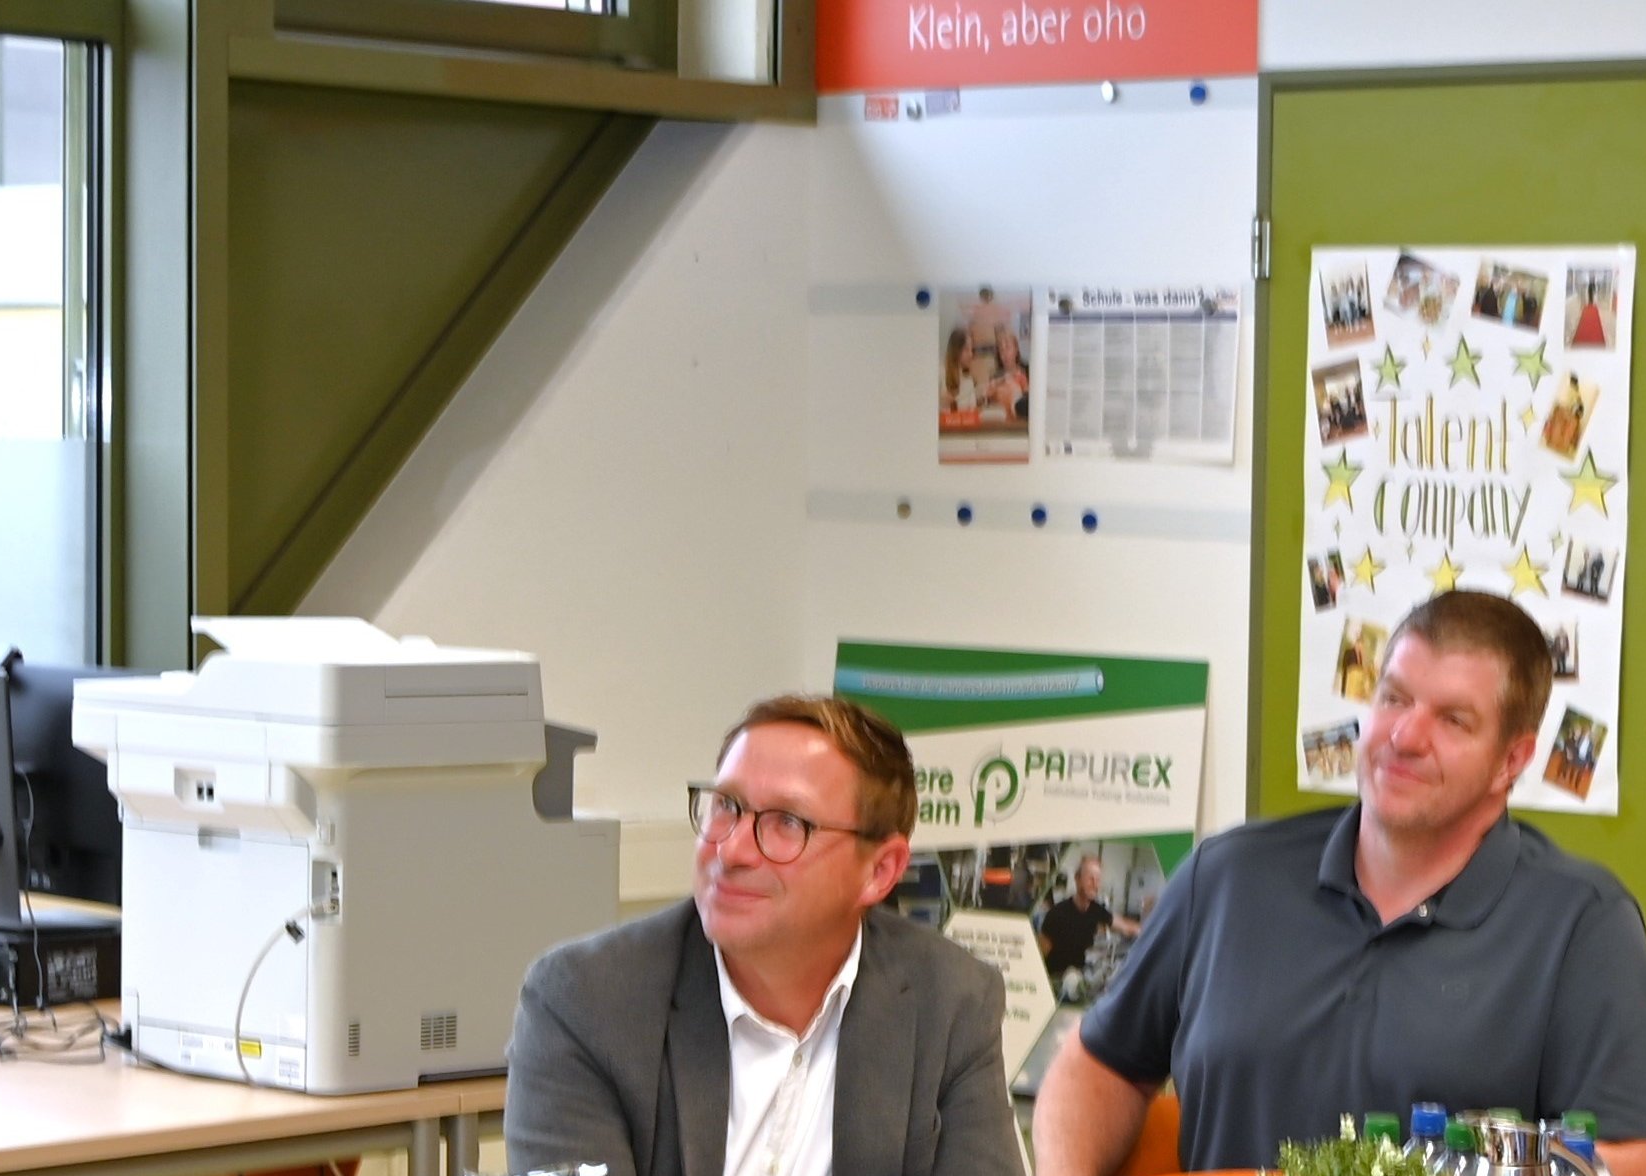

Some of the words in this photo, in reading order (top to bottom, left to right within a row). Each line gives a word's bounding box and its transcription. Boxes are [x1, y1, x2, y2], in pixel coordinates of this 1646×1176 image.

[908, 4, 989, 54] Klein,
[1001, 2, 1071, 47] aber
[1083, 0, 1146, 42] oho
[1082, 288, 1123, 306] Schule
[1133, 290, 1159, 306] was
[1371, 392, 1514, 475] Talent
[1025, 745, 1173, 789] PAPUREX
